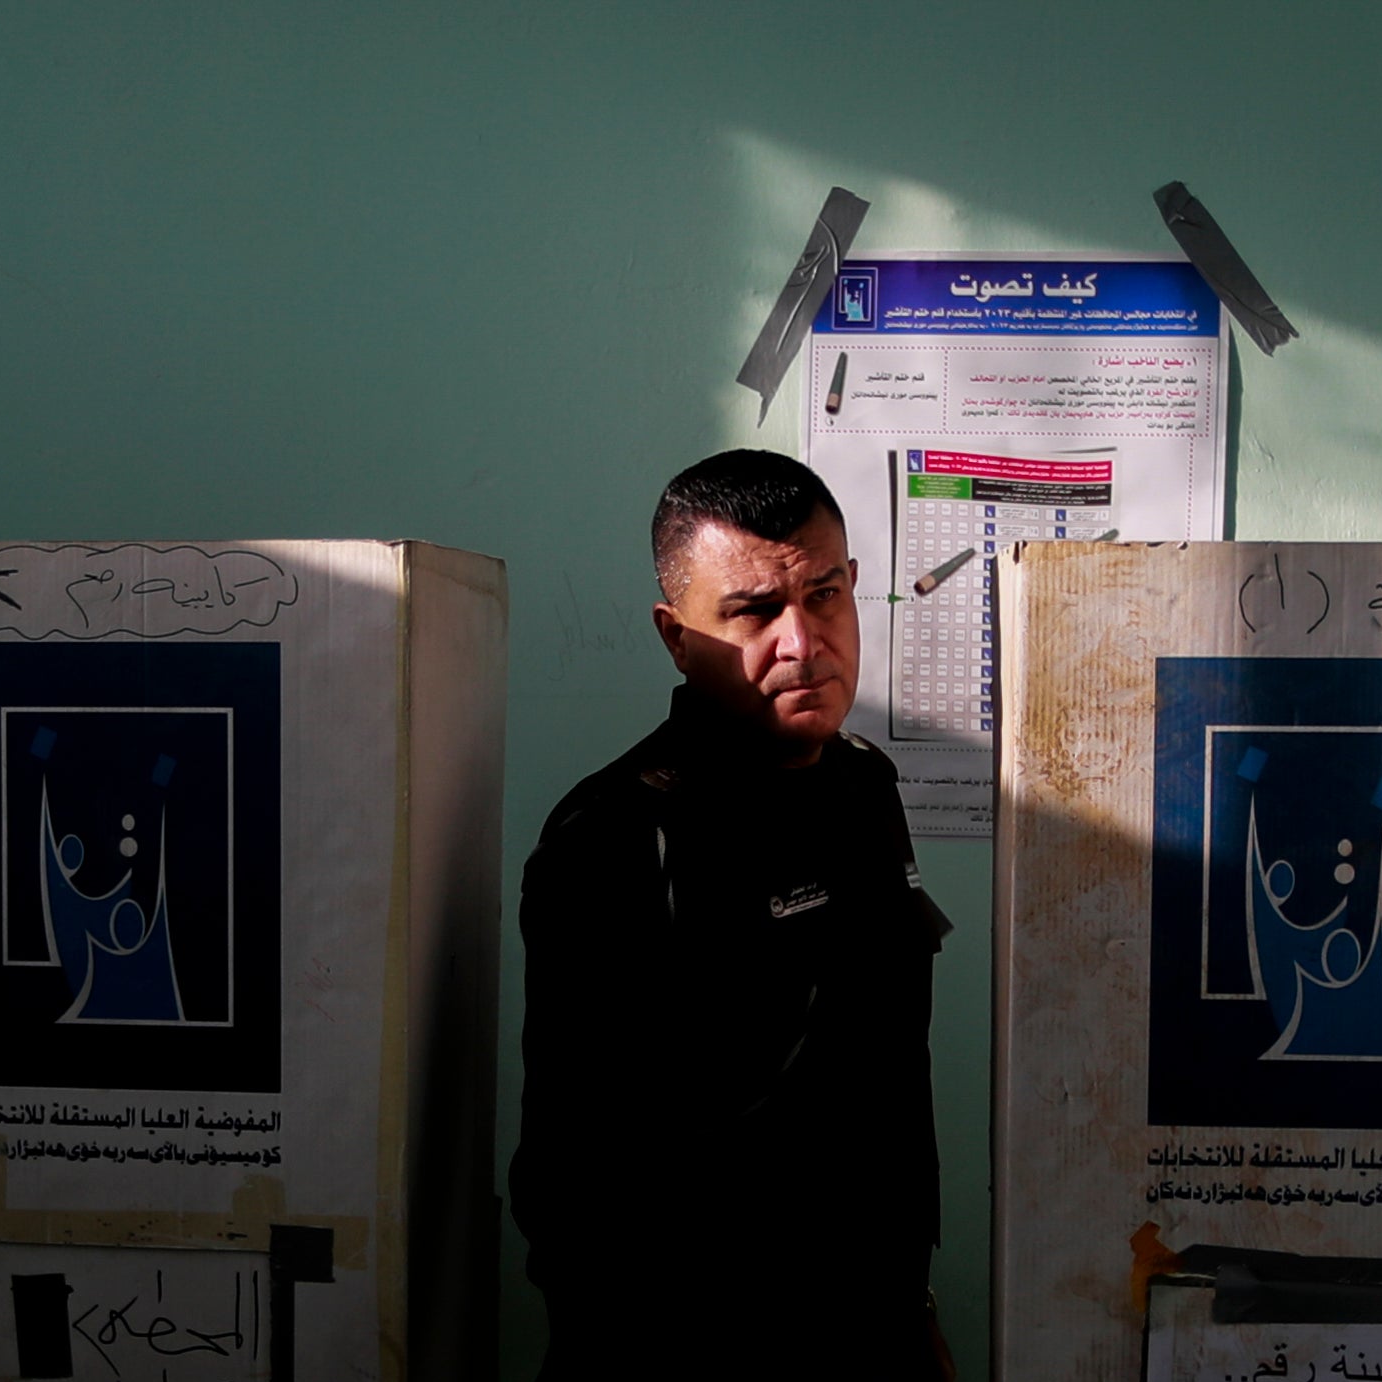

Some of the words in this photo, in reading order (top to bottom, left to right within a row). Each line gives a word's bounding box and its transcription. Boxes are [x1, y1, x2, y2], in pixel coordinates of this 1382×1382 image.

[950, 272, 1034, 303] تصوت
[1042, 272, 1098, 304] كيف
[50, 1102, 136, 1129] المستقلة
[141, 1107, 189, 1135] العليا
[195, 1106, 282, 1137] المفوضية
[1146, 1145, 1244, 1173] للانتخابات
[1249, 1143, 1345, 1170] المستقلة
